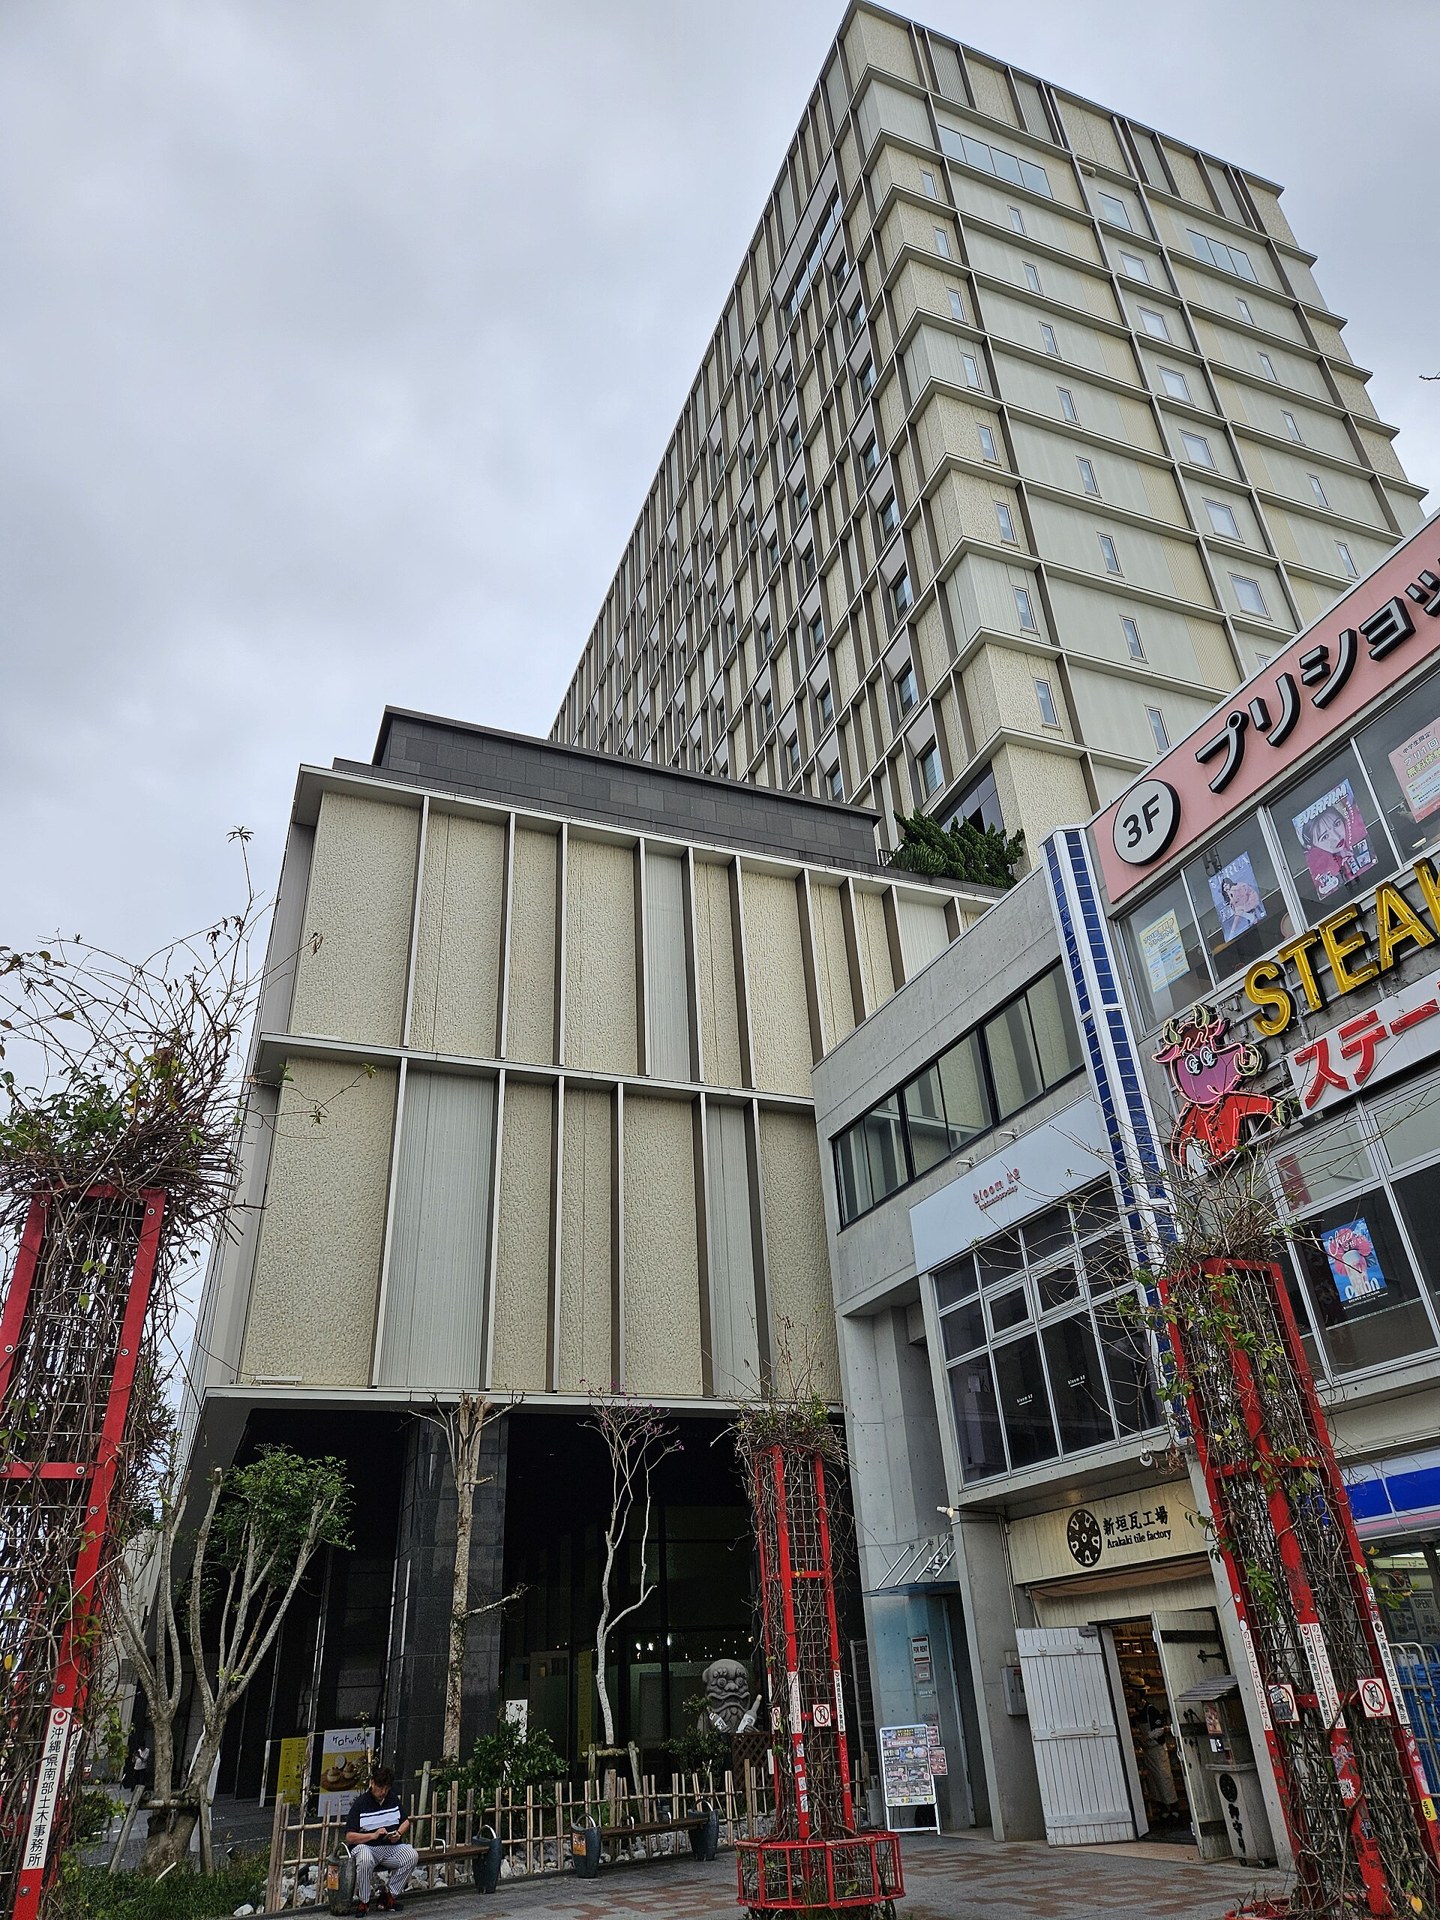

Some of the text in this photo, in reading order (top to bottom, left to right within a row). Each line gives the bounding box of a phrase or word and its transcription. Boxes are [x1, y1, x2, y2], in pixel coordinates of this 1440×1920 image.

[1195, 558, 1440, 794] プリショッ
[1122, 794, 1160, 848] 3F
[1297, 784, 1348, 826] EVERFILM
[1294, 982, 1440, 1110] ステー
[973, 1180, 1003, 1204] bloom
[1102, 1505, 1168, 1536] 新垣瓦工場
[1107, 1529, 1171, 1548] Arakaki tile factory
[27, 1726, 65, 1868] 沖縄県南部土木事務所
